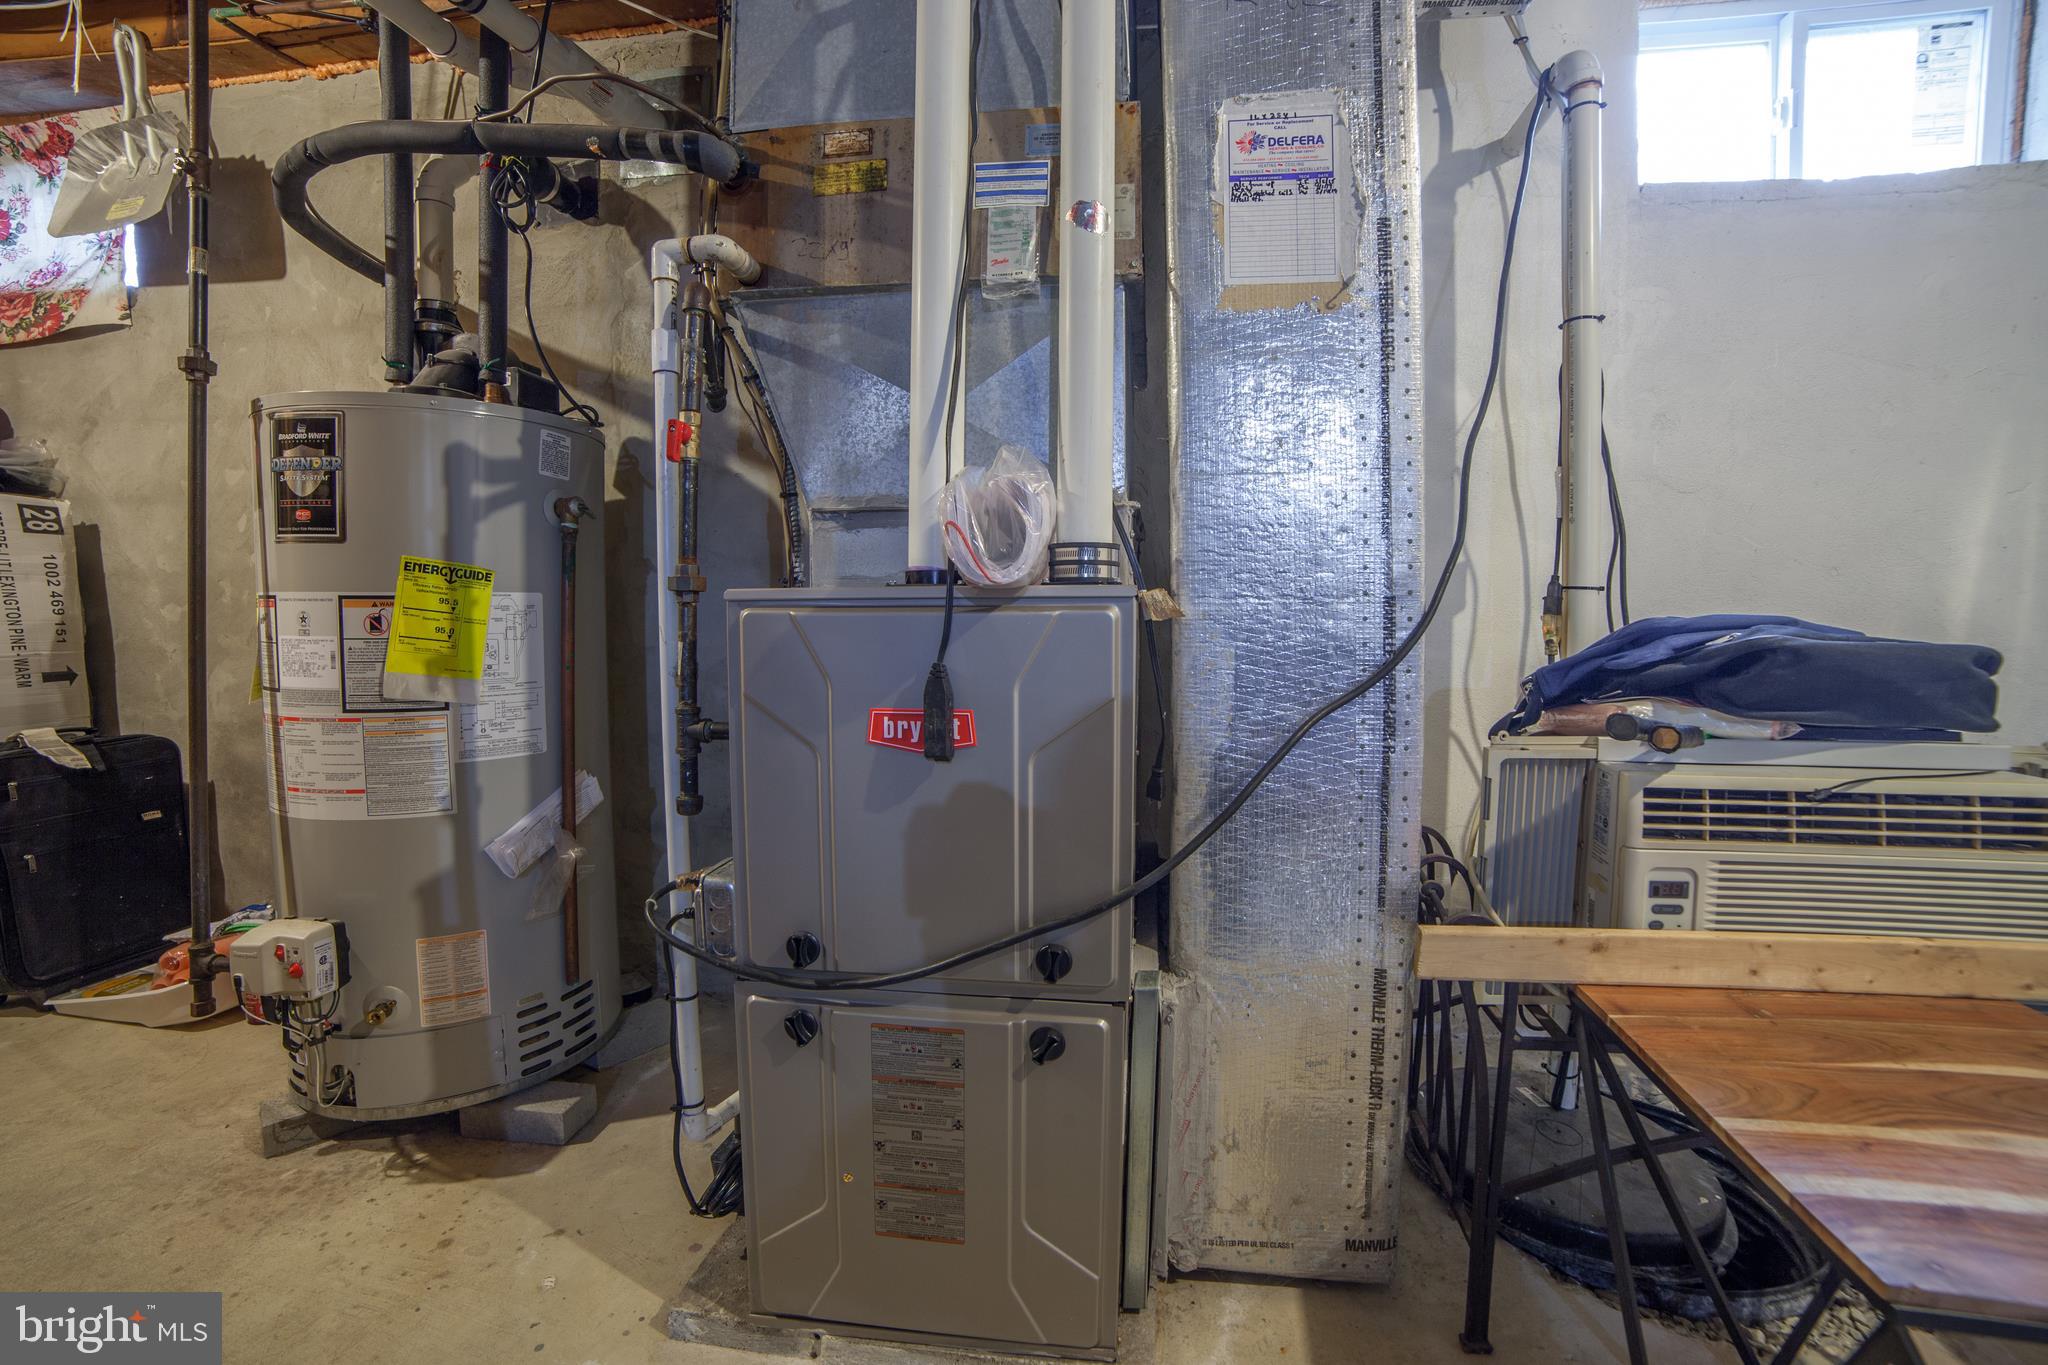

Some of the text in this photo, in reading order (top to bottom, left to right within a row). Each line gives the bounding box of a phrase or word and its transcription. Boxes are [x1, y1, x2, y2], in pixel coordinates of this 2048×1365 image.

[1268, 135, 1325, 147] DELFERA
[278, 432, 331, 440] BRADFORD WHITE
[271, 456, 343, 472] DEFENDER
[21, 506, 60, 533] 28
[403, 560, 493, 584] ENERGYGUIDE
[0, 569, 22, 629] LEXINGTON
[43, 554, 67, 644] 1002 469 151
[438, 597, 459, 606] 95.5
[9, 629, 28, 652] PINE
[434, 626, 455, 635] 95.0
[14, 657, 33, 689] WARM
[883, 716, 960, 743] bryt
[1380, 830, 1388, 853] LISTED
[1372, 968, 1388, 1024] MANVILLE
[1369, 1026, 1386, 1100] THERM-LOCK
[1215, 1239, 1237, 1247] LISTED
[1345, 1236, 1398, 1252] MANVILLE
